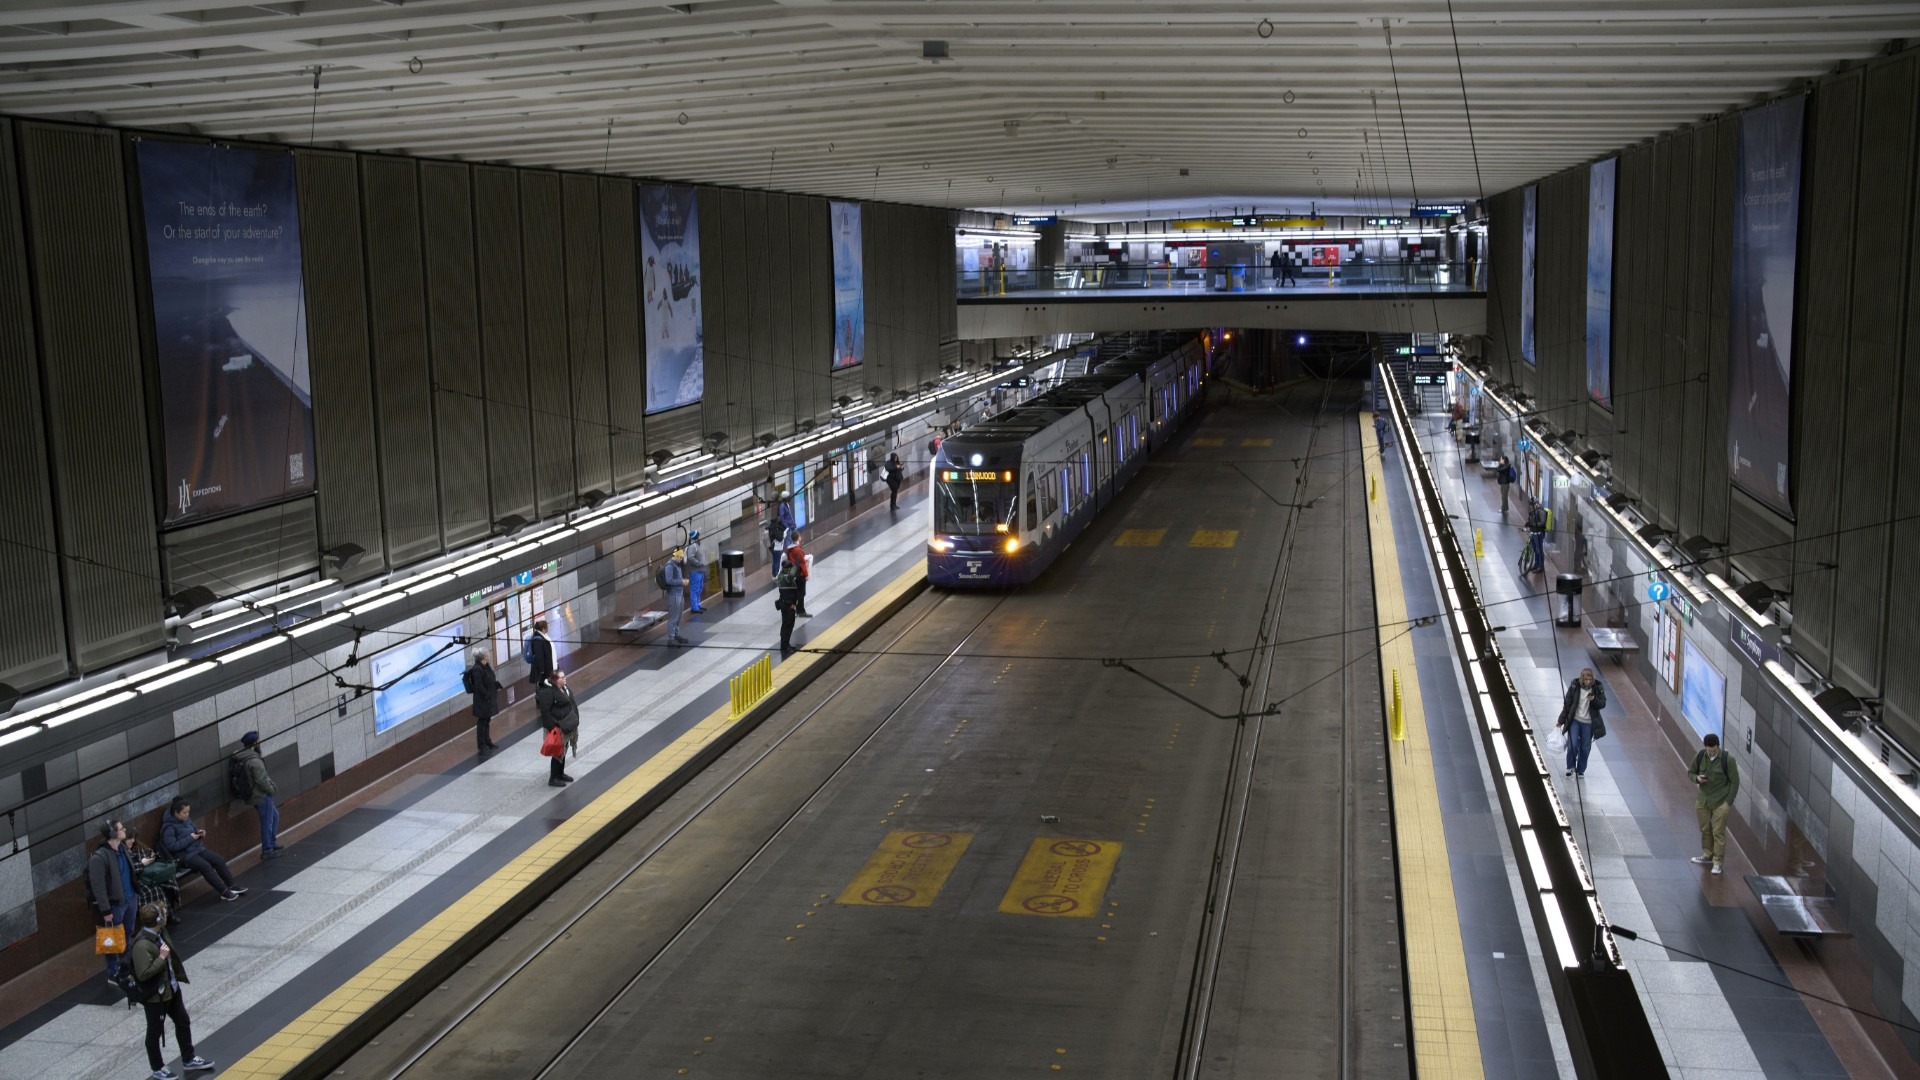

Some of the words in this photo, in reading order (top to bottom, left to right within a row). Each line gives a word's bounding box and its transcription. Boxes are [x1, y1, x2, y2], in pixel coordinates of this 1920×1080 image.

[178, 201, 194, 216] The
[197, 201, 216, 216] ends
[218, 201, 226, 216] of
[229, 202, 242, 217] the
[243, 203, 268, 217] earth?
[163, 224, 175, 239] Or
[178, 224, 192, 239] the
[194, 225, 212, 239] start
[211, 224, 220, 239] of
[223, 227, 240, 243] your
[242, 224, 283, 240] adventure?
[192, 485, 222, 497] EXPEDITIONS
[896, 850, 913, 859] TO
[877, 860, 906, 884] CROSS
[1039, 860, 1066, 890] ILLEGAL
[1067, 859, 1090, 883] CROSS
[1061, 884, 1080, 893] TO
